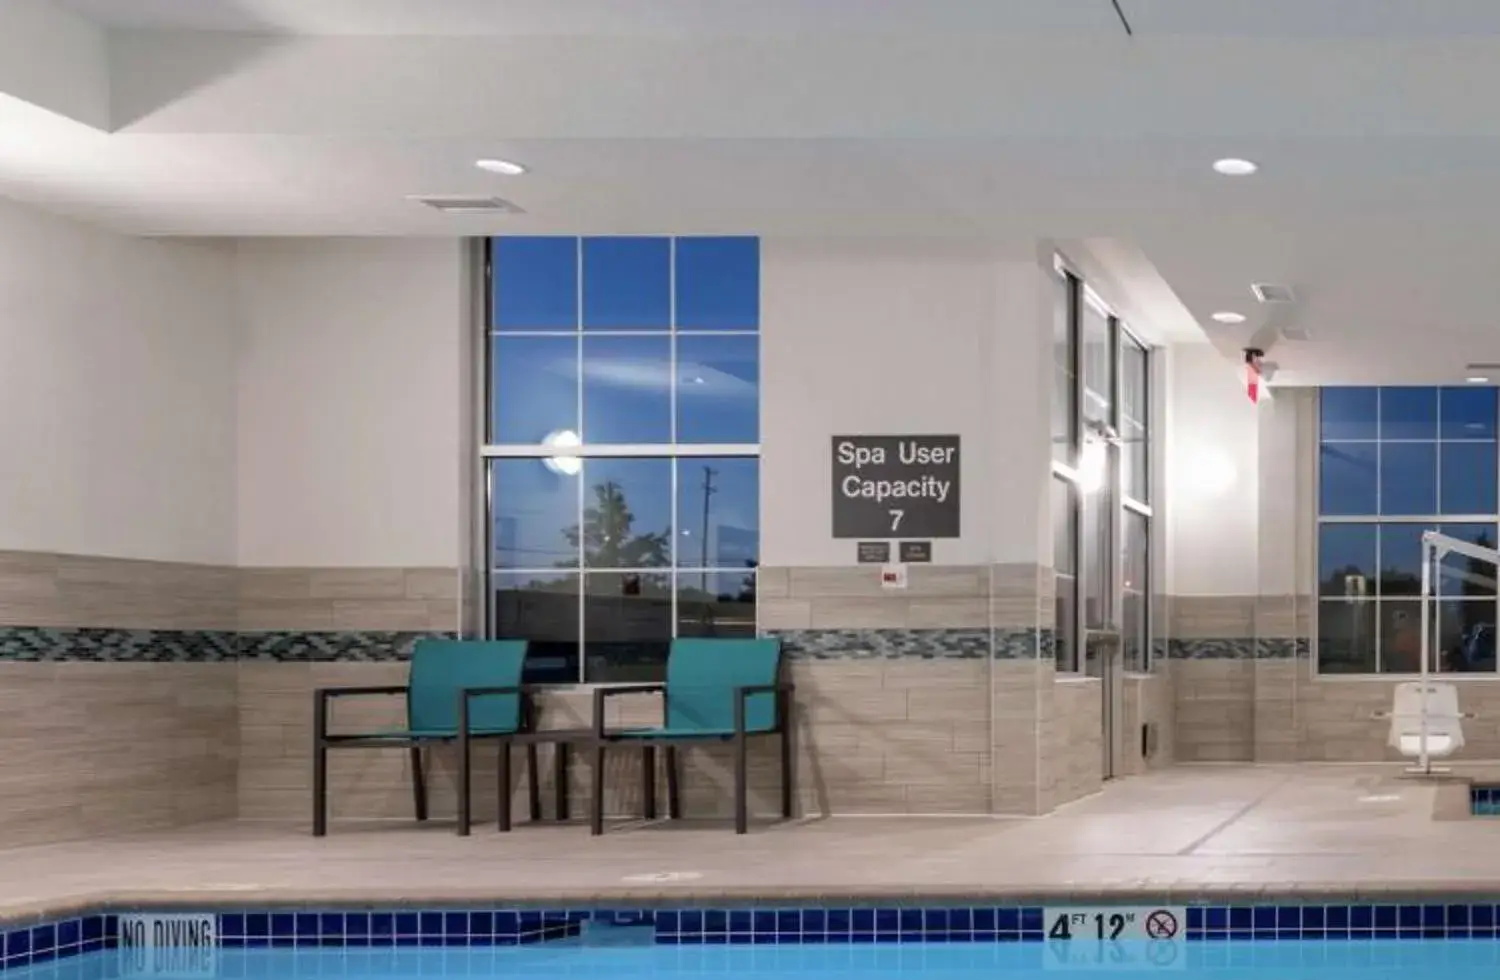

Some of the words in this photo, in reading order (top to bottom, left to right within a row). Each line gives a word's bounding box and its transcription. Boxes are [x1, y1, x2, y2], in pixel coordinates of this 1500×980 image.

[838, 441, 885, 469] Spa
[898, 441, 955, 464] User
[842, 475, 950, 502] Capacity
[888, 509, 904, 531] 7
